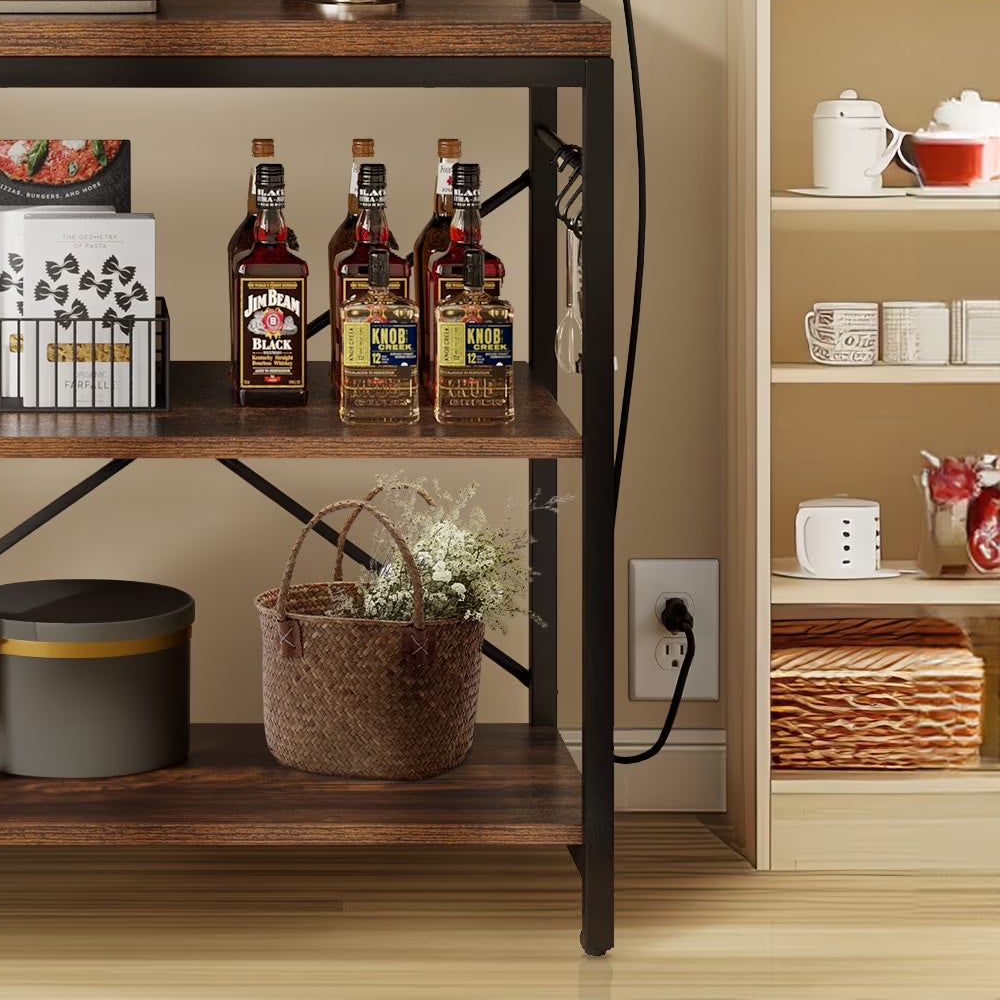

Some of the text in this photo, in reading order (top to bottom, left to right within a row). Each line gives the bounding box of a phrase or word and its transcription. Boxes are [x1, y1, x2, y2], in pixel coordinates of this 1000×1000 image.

[26, 192, 62, 200] BURGERS,
[82, 181, 101, 193] MORE
[244, 289, 300, 318] JIM BEAM
[252, 338, 292, 350] BLACK
[372, 328, 405, 344] KNOB
[467, 328, 500, 344] KNOB
[372, 353, 381, 364] 12
[467, 353, 476, 364] 12
